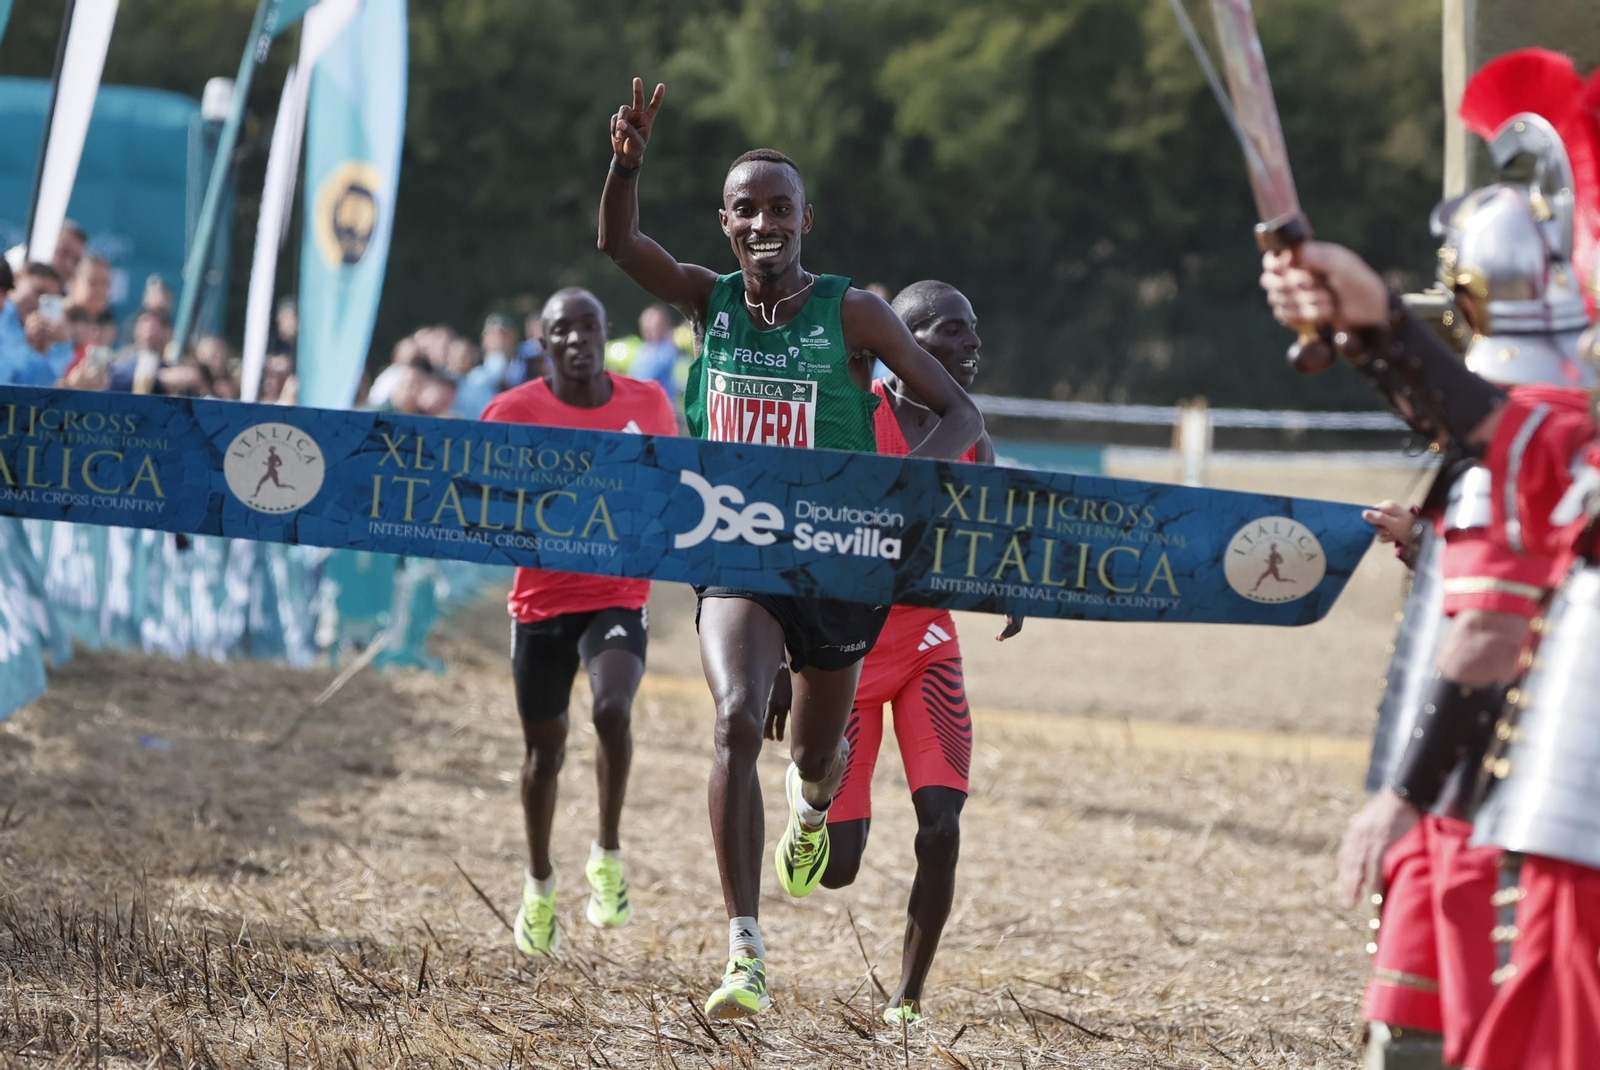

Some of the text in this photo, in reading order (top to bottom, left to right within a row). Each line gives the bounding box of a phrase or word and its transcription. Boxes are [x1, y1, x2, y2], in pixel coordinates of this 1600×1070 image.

[733, 347, 787, 368] Facsa
[731, 380, 783, 397] ITÁLICA
[40, 408, 137, 435] CROSS
[709, 391, 808, 448] KWIZERA
[39, 430, 170, 451] INTERNACIONAL
[377, 432, 592, 476] XLIII CROSS
[492, 467, 626, 491] INTERNACIONAL
[42, 491, 90, 507] CROSS
[91, 495, 166, 513] COUNTRY
[369, 472, 620, 541] ITÁLICA
[795, 500, 904, 527] Diputación
[939, 482, 1156, 530] XLIII CROSS
[368, 521, 619, 558] INTERNATIONAL CROSS COUNTRY
[793, 522, 902, 560] Sevilla
[1055, 521, 1188, 548] INTERNACIONAL
[930, 524, 1183, 597] ITÁLICA
[930, 576, 1182, 610] INTERNATIONAL CROSS COUNTRY
